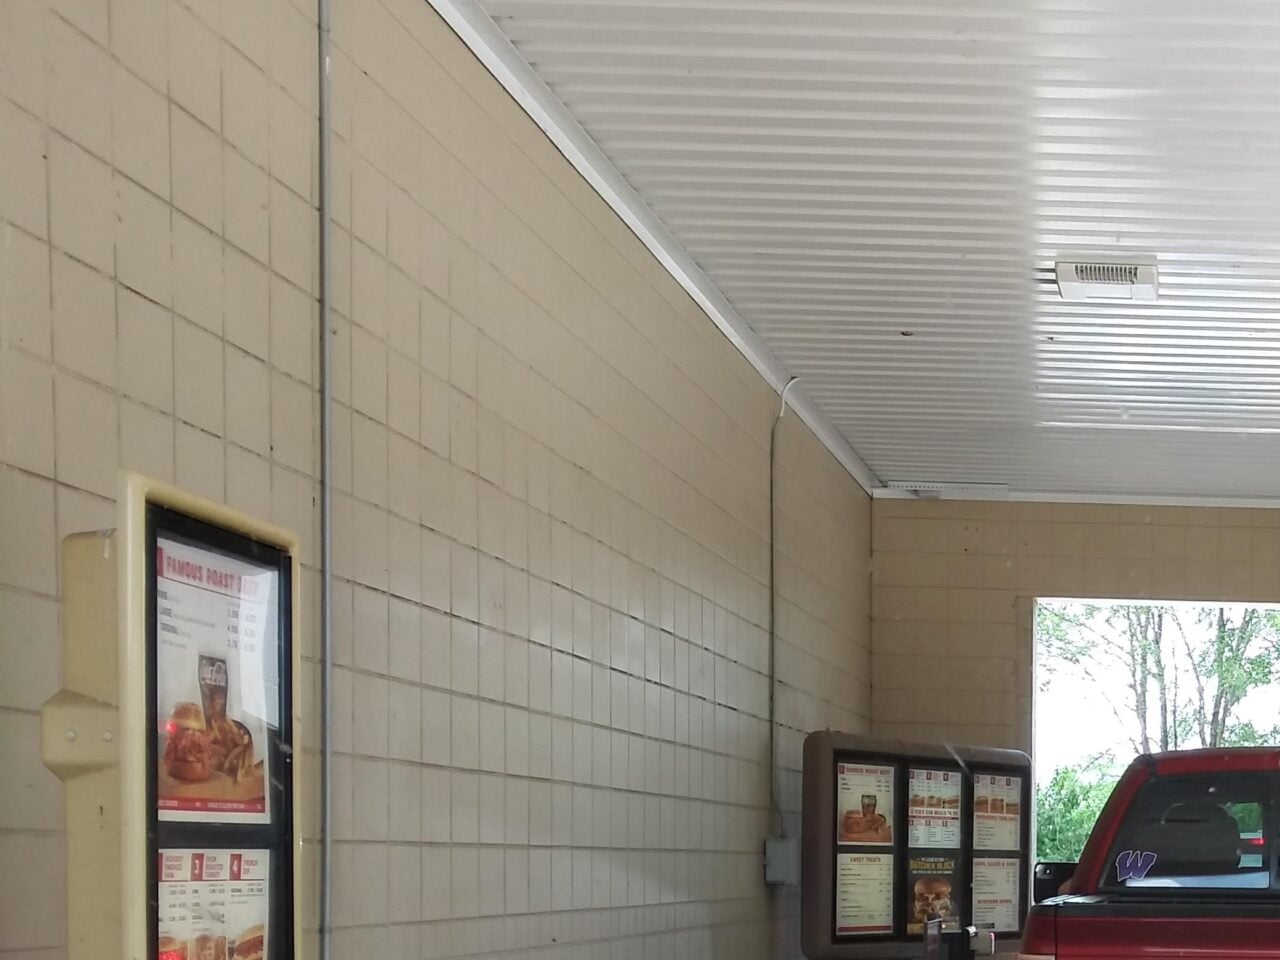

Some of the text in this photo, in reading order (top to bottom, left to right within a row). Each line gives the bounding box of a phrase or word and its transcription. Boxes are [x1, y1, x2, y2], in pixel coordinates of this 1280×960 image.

[166, 555, 203, 582] FAMOUS
[194, 860, 199, 874] 3
[232, 860, 238, 873] 4
